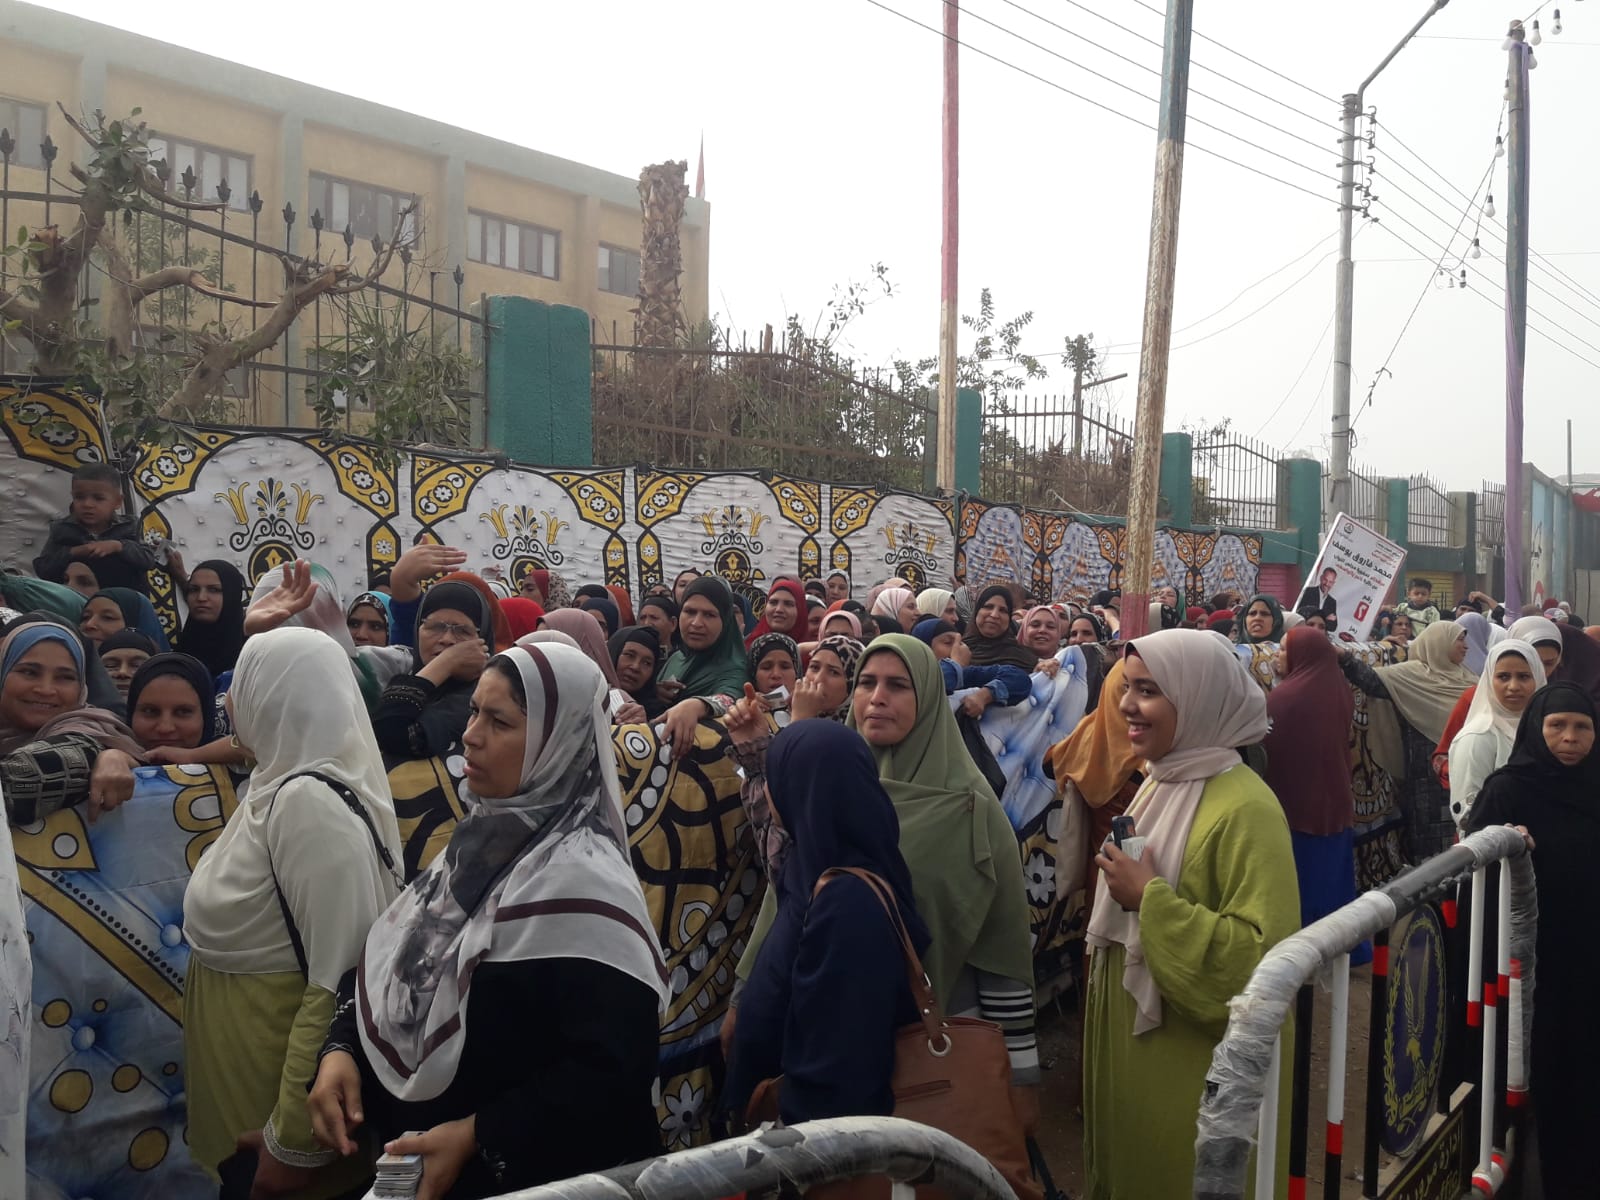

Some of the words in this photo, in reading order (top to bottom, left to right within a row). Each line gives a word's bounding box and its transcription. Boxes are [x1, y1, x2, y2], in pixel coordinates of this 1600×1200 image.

[1332, 540, 1352, 557] يوسف
[1352, 554, 1373, 568] فاروق
[1373, 565, 1392, 579] محمد
[1362, 594, 1373, 604] رقم
[1348, 625, 1358, 634] رمز
